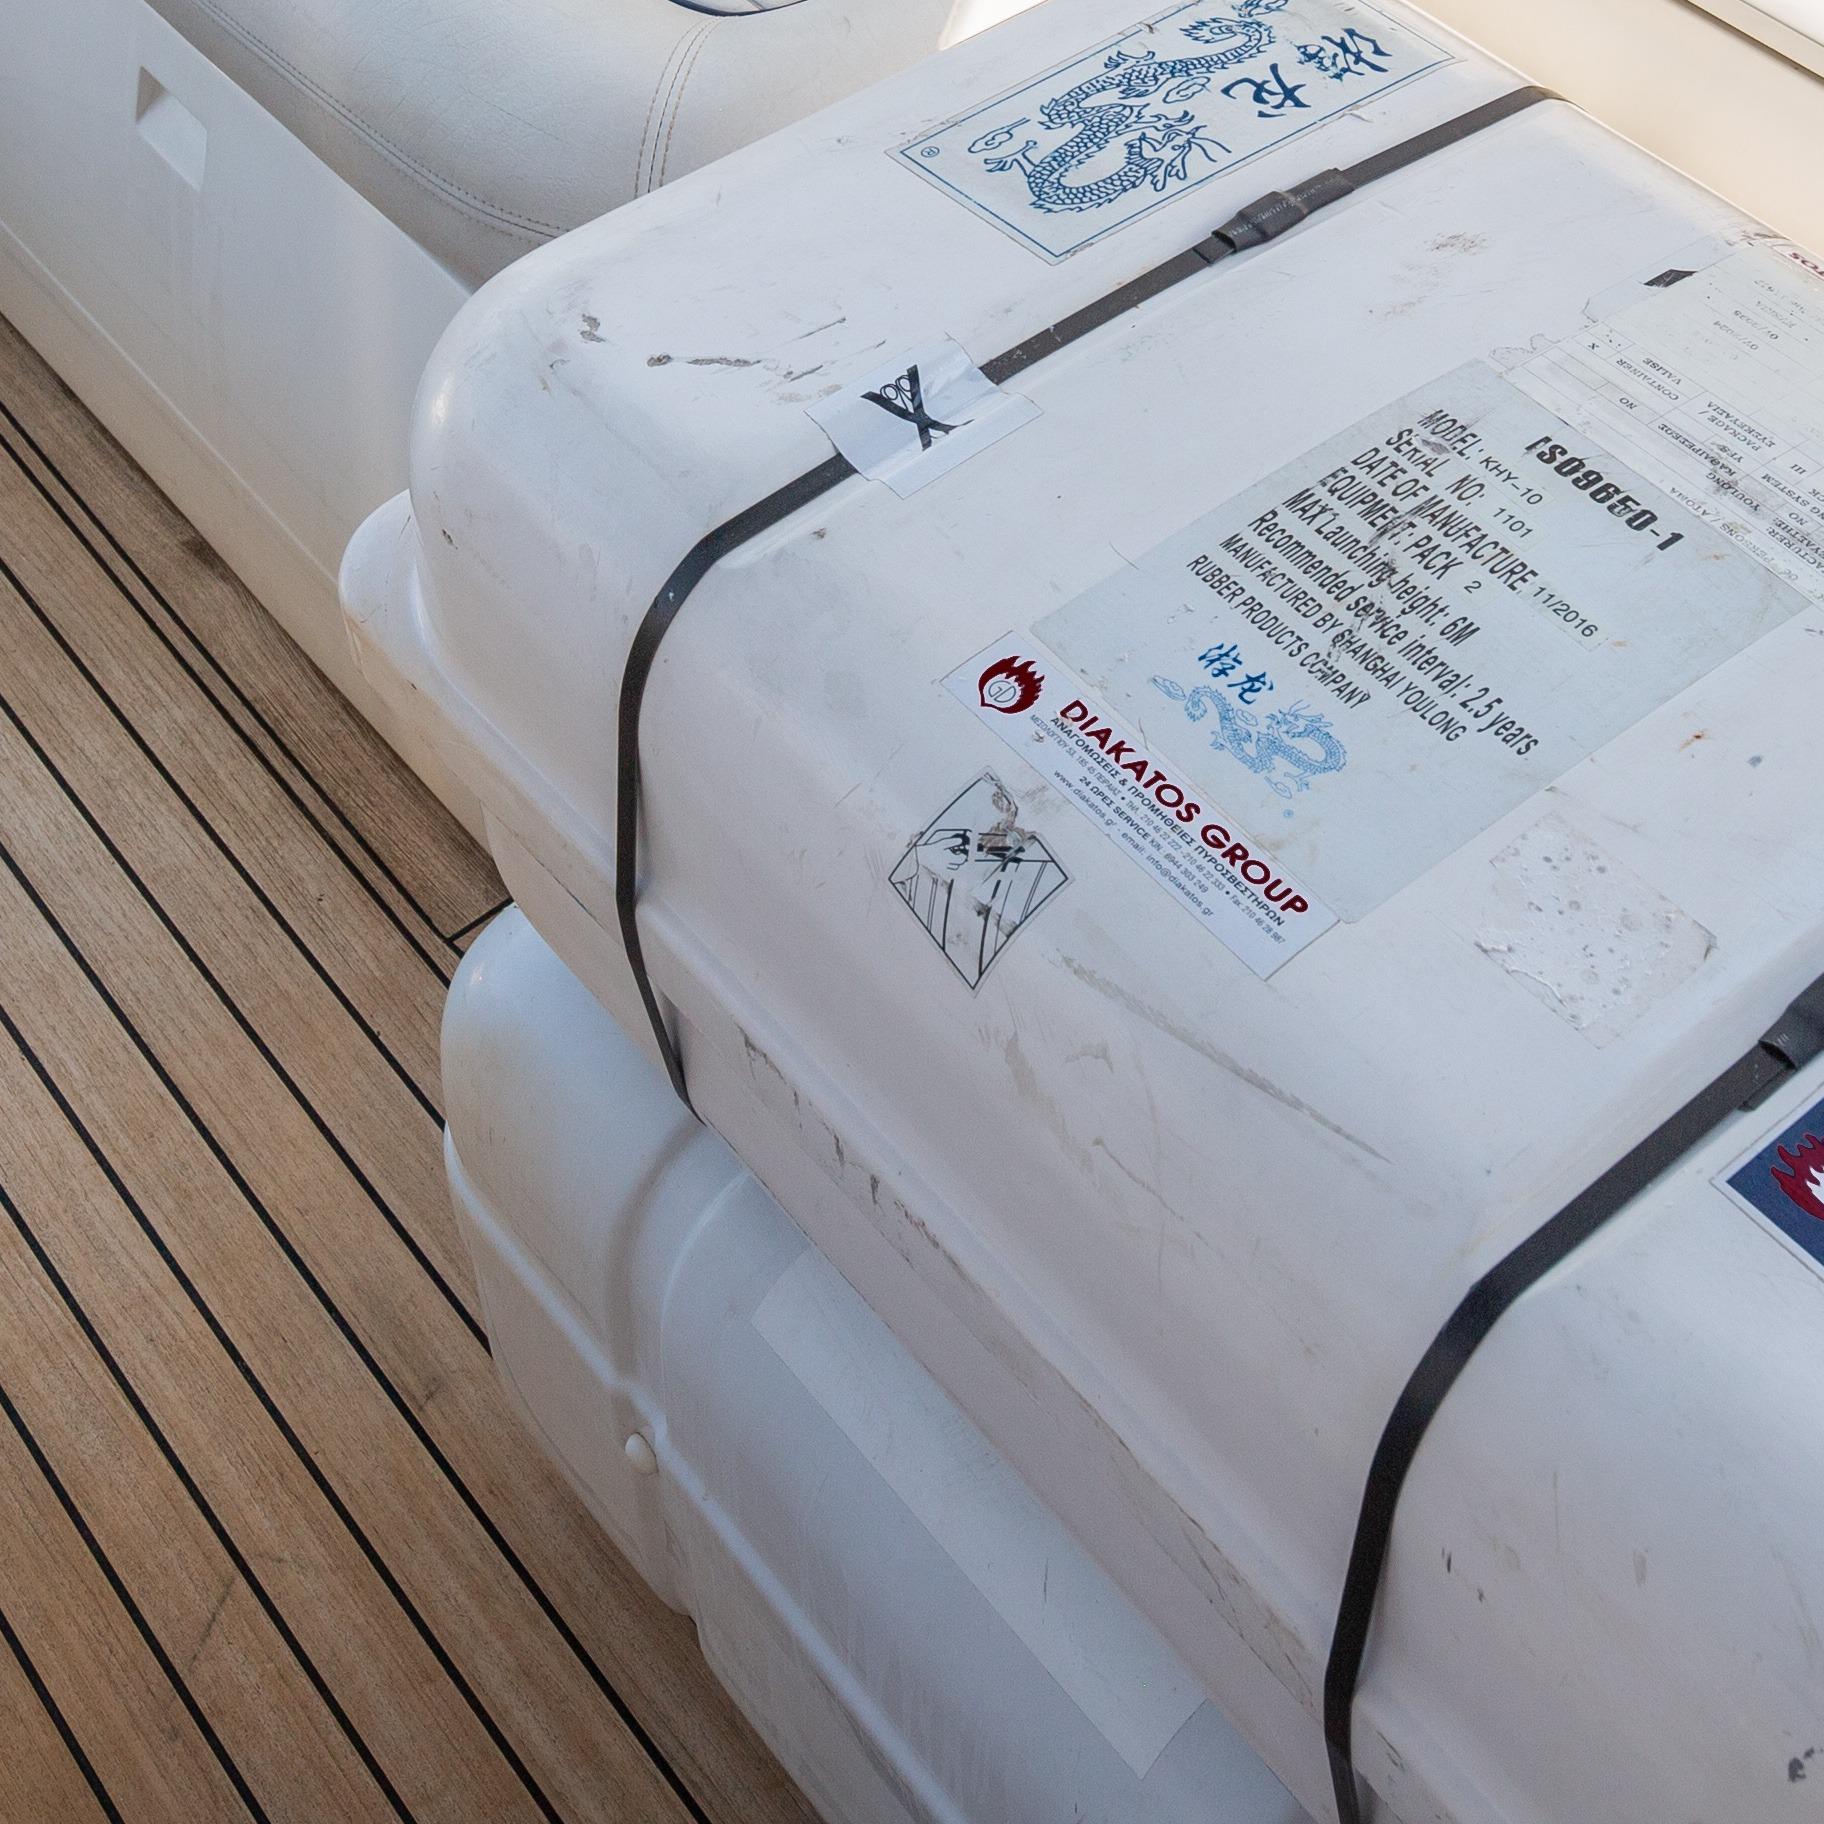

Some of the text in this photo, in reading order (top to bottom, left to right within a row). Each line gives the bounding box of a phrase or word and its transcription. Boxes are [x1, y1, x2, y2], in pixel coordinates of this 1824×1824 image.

[1616, 395, 1639, 410] NO
[1415, 408, 1547, 507] MODEL: KHY-10
[1443, 473, 1493, 507] NO:
[1489, 505, 1535, 539] 1101
[1703, 470, 1763, 511] YOULONG
[1759, 472, 1811, 508] SYSTEM
[1279, 487, 1482, 647] MAX Launching height: 6M
[1348, 446, 1409, 488] DATE
[1386, 475, 1431, 505] OF
[1528, 584, 1601, 639] 11/2016
[1400, 533, 1466, 581] PACK
[1461, 578, 1484, 594] 2
[1184, 554, 1248, 603] RUBBER
[1231, 594, 1313, 659] PRODUCTS
[1215, 532, 1471, 743] MANUFACTURED BY SHANGHAI YOULONG
[1244, 508, 1543, 762] Recommended service interval: 2.5 years
[1051, 768, 1119, 829] www.diakatos.gr
[1143, 852, 1217, 919] info@diakatos.gr
[1057, 697, 1313, 921] DIAKATOS GROUP
[1110, 805, 1151, 841] SERVICE
